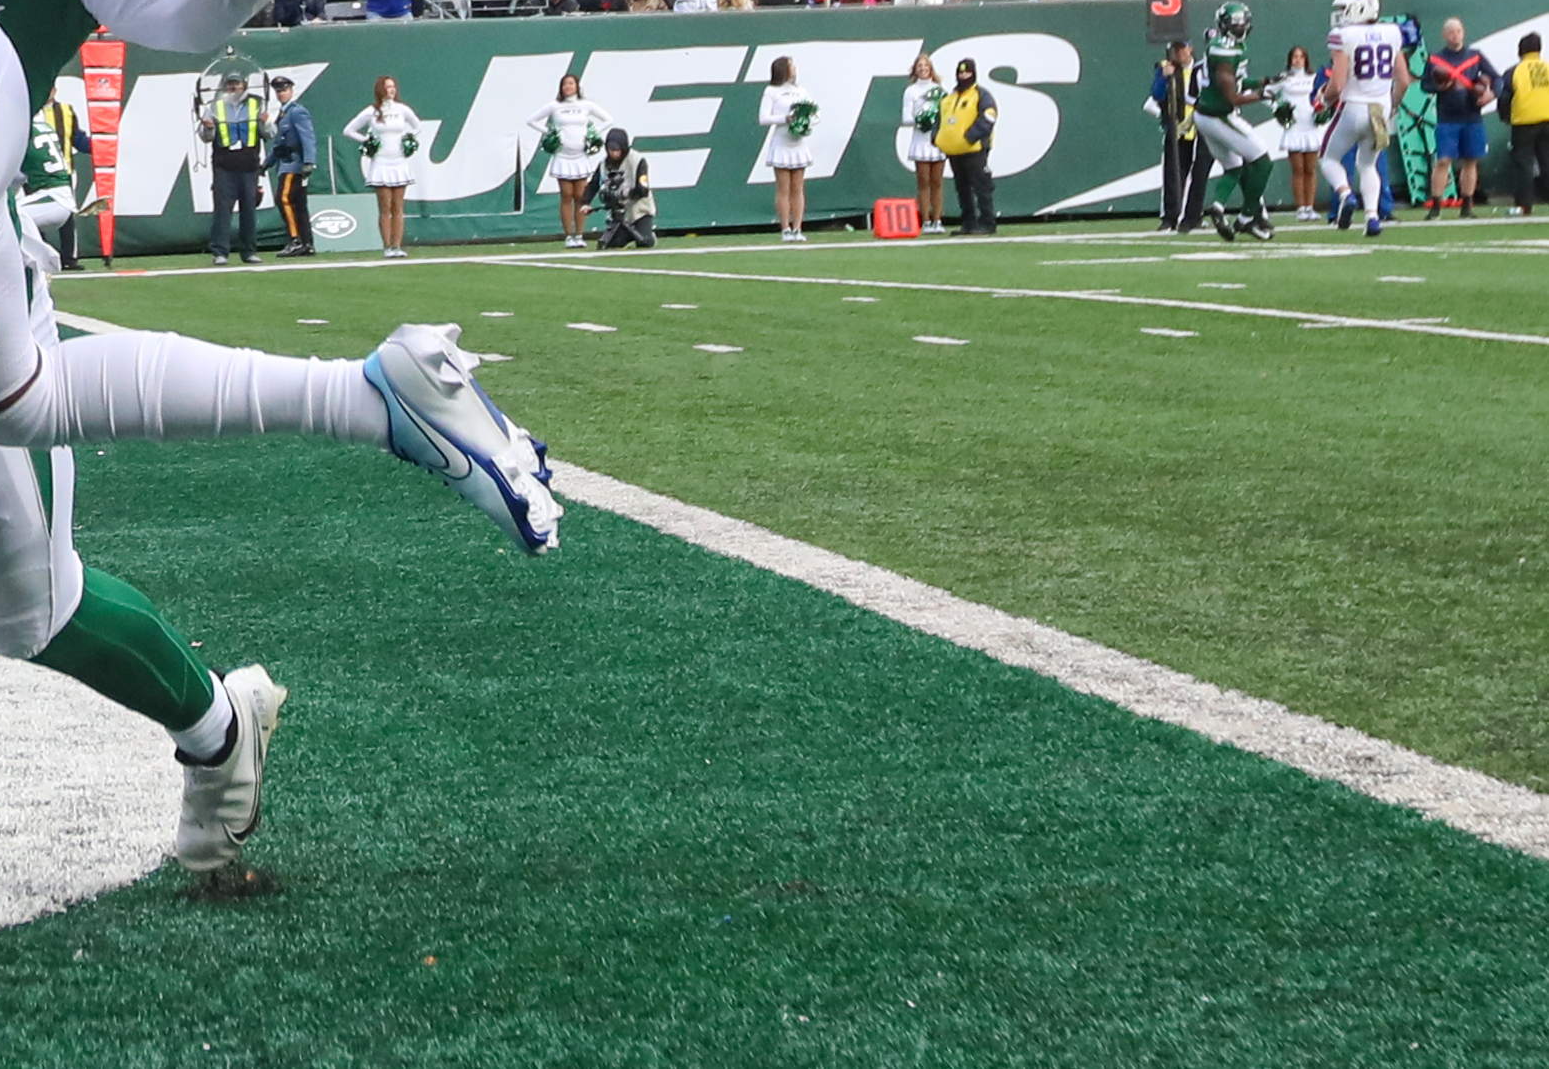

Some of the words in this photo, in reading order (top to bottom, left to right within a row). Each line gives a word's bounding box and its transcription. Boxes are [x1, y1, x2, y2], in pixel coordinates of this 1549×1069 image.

[1354, 44, 1394, 80] 88
[359, 33, 1081, 202] JETS
[884, 205, 912, 233] 10
